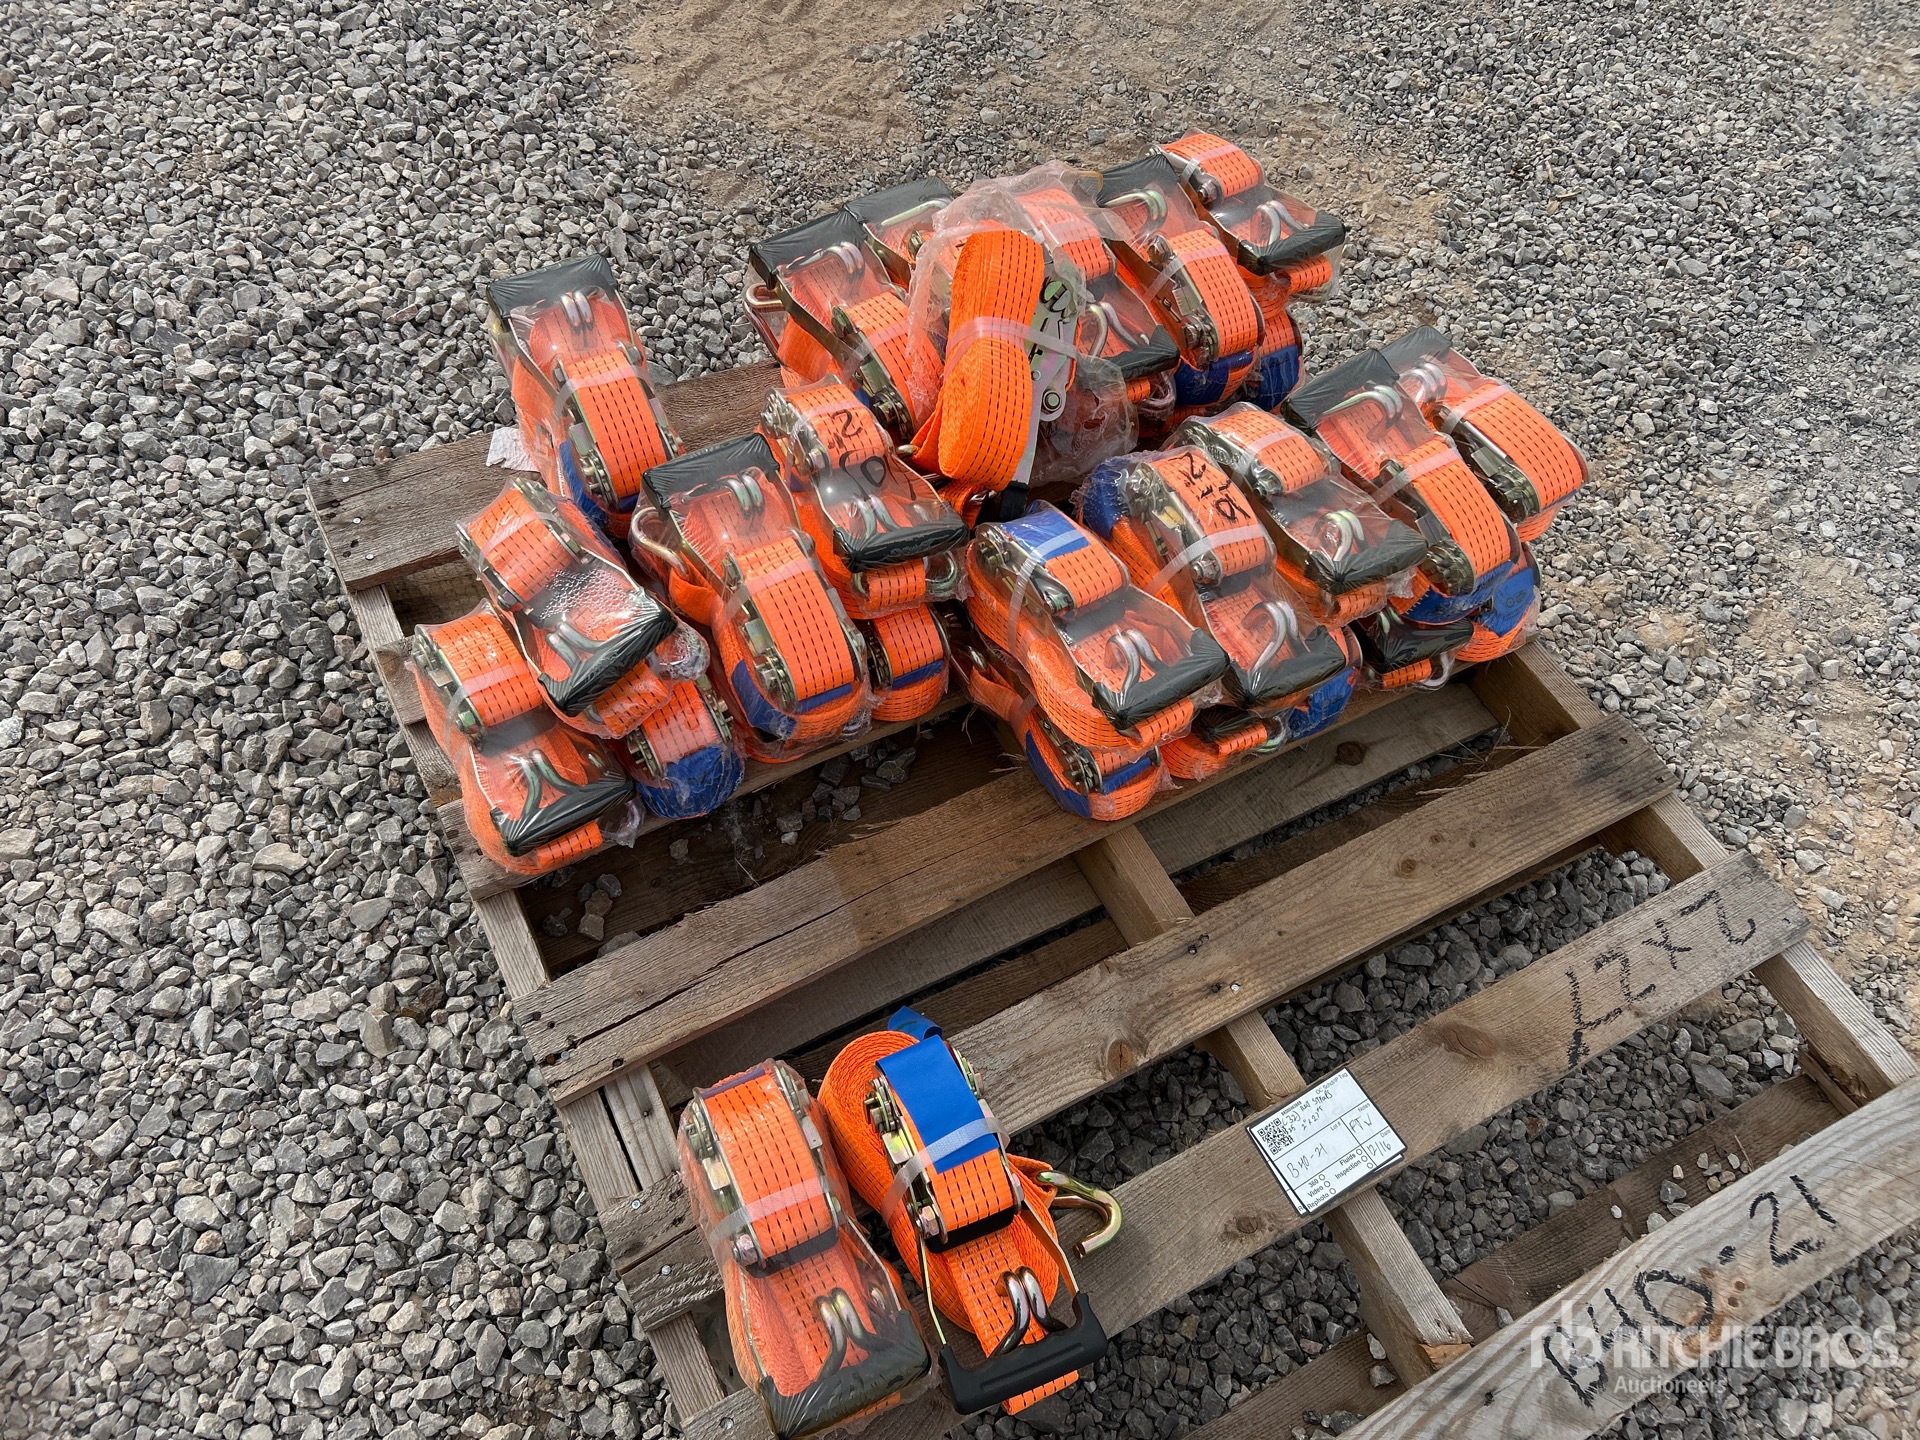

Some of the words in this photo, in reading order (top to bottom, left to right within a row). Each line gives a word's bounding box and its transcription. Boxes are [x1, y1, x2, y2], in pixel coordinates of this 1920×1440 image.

[1379, 1129, 1391, 1138] Date
[1339, 1153, 1357, 1167] Fluids
[1334, 1159, 1362, 1180] Inspection
[1307, 1185, 1324, 1198] Video
[1306, 1192, 1330, 1210] Rephoto
